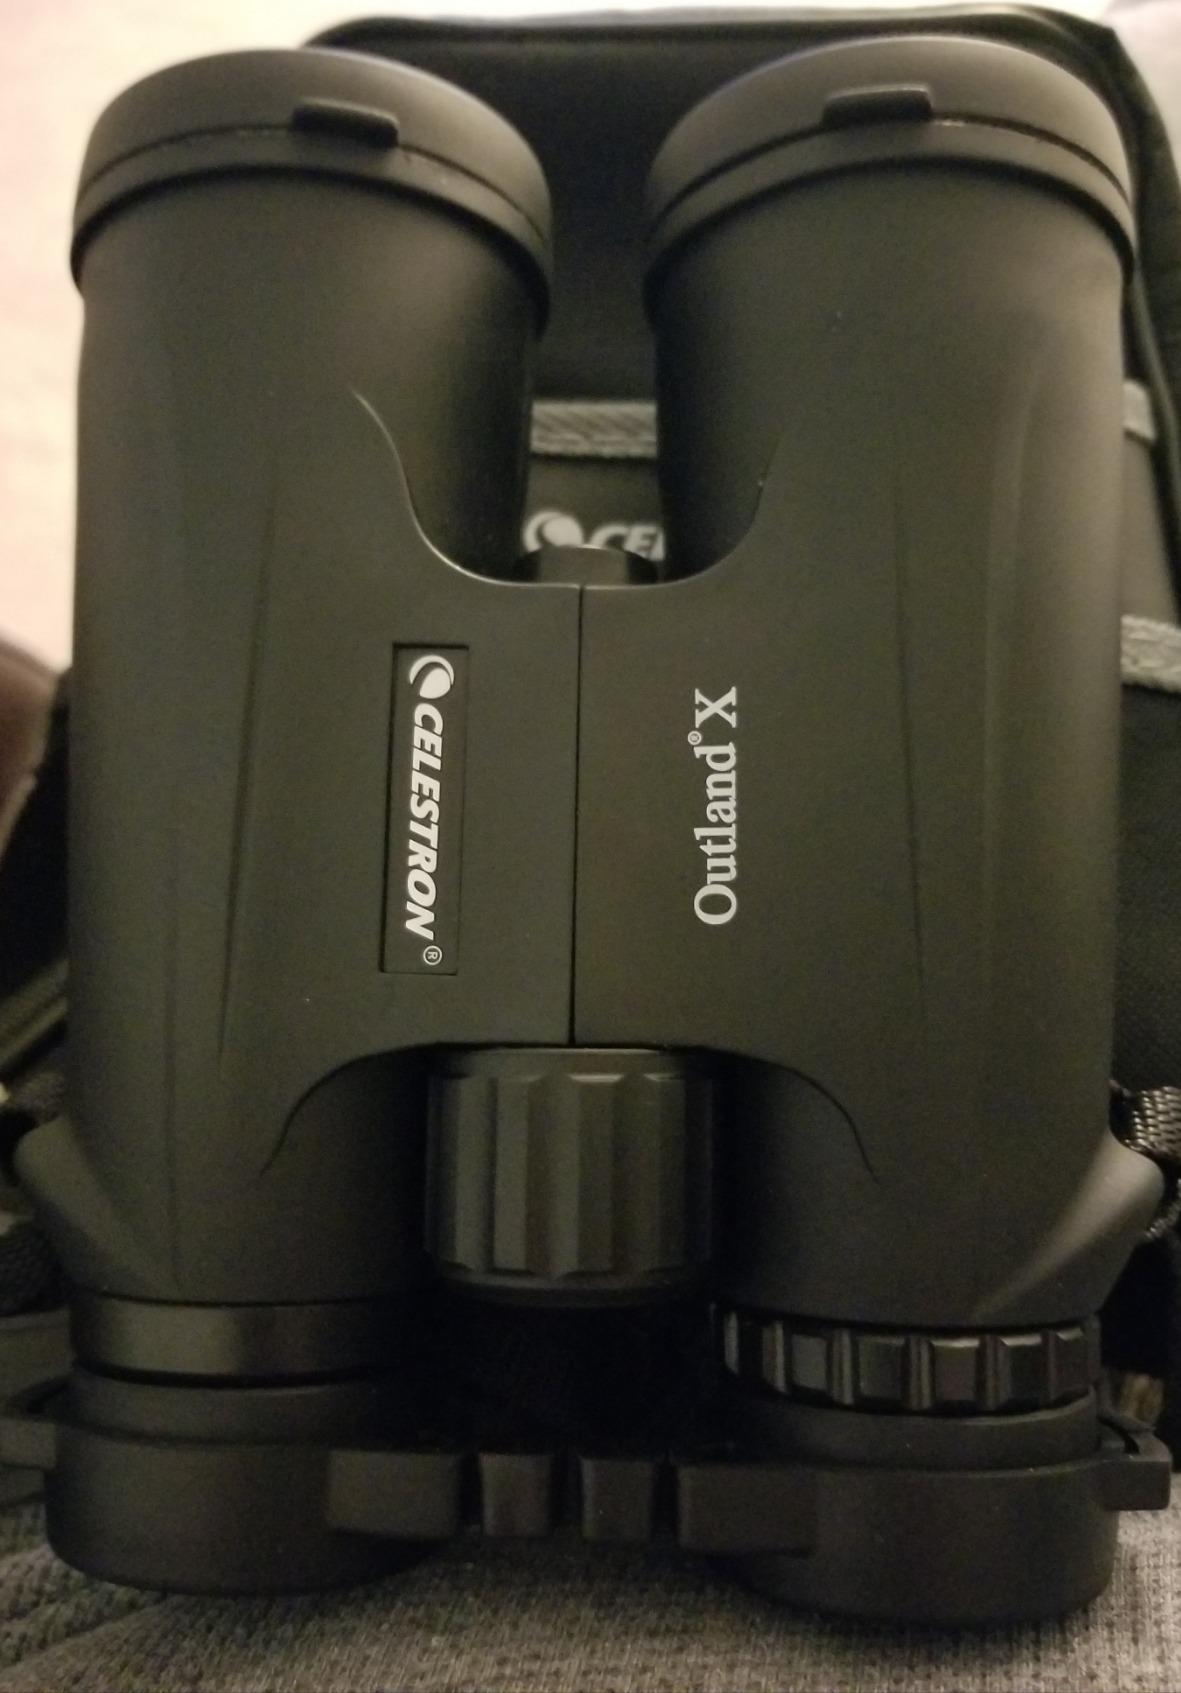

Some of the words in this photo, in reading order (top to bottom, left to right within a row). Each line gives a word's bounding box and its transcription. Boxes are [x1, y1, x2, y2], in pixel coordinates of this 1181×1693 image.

[694, 686, 737, 728] X
[405, 703, 444, 941] CELESTRON
[693, 742, 737, 926] Outland
